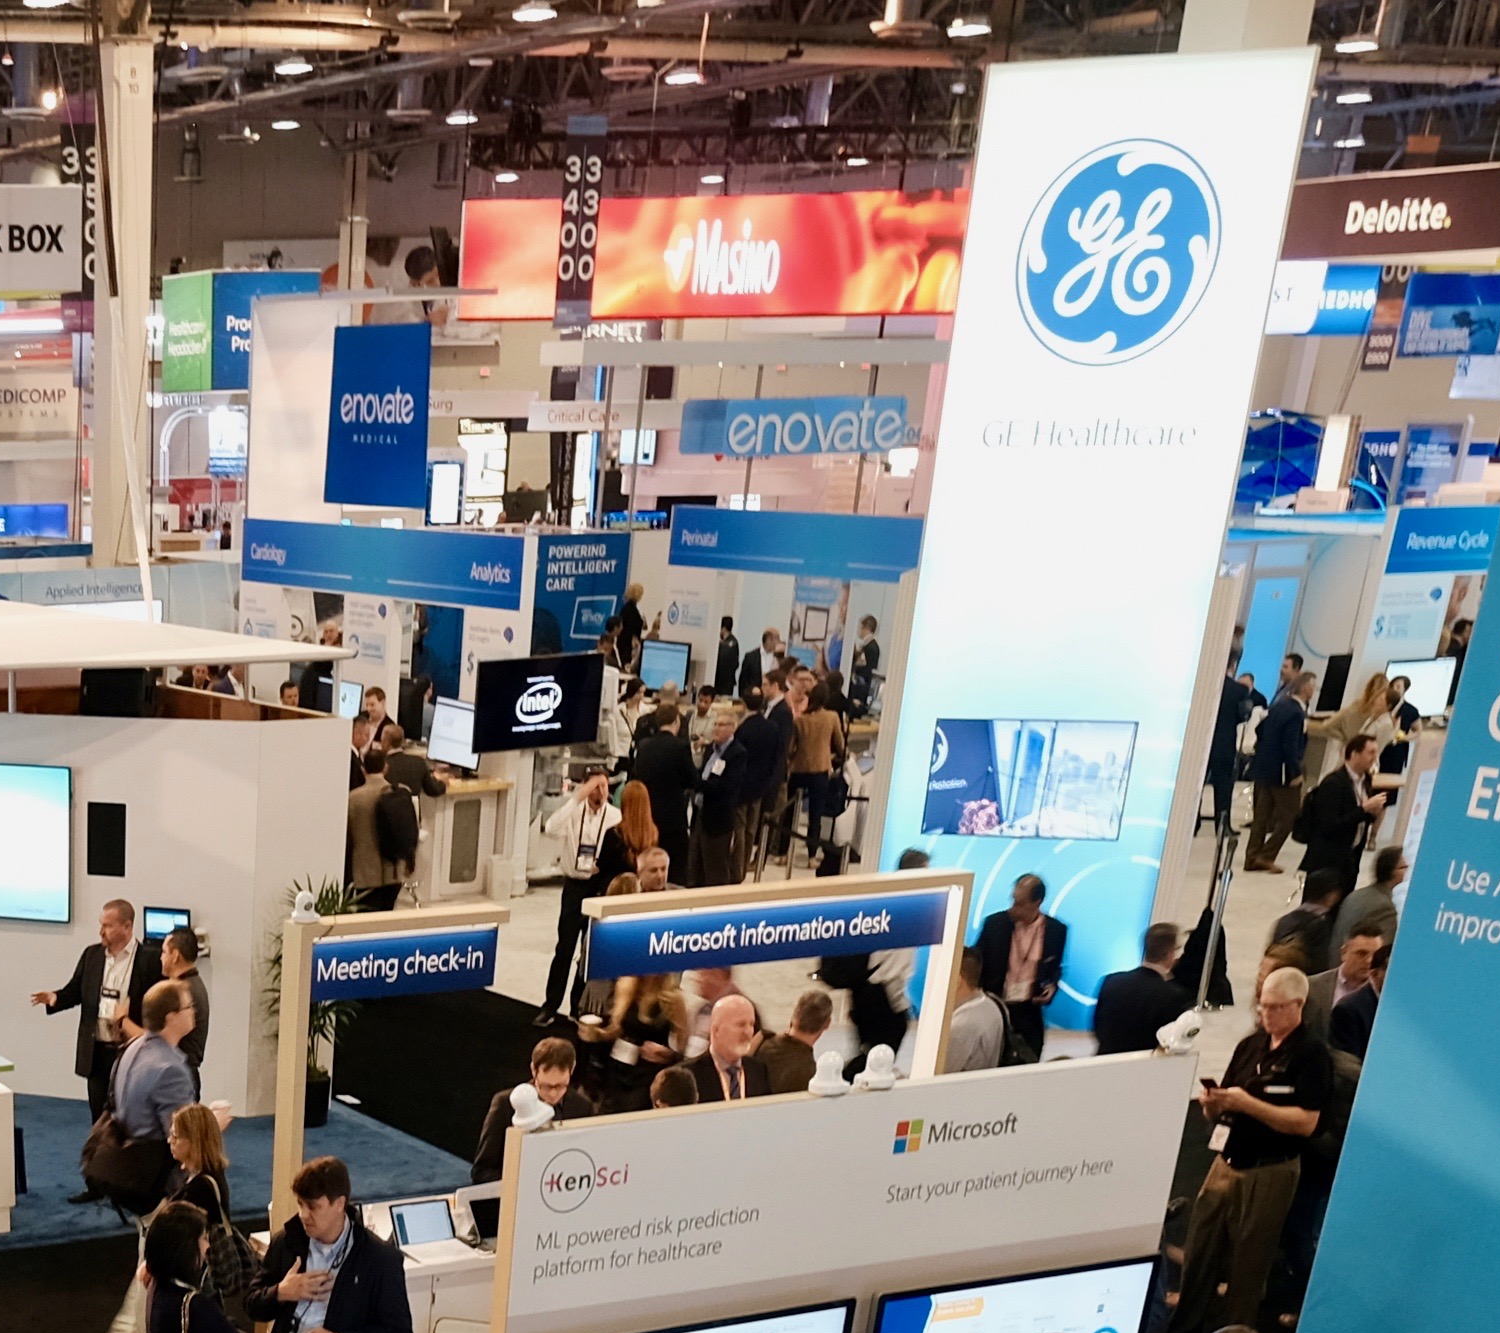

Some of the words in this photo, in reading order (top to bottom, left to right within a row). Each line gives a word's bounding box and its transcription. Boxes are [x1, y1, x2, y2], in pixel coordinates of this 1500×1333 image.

[1345, 197, 1451, 234] Deloitte.
[8, 225, 64, 252] BOX
[341, 385, 414, 425] enovate
[353, 435, 397, 444] MEDICAL
[728, 400, 901, 454] enovate
[982, 420, 1016, 447] GE
[1033, 418, 1196, 447] Healthcare
[549, 544, 606, 559] POWERING
[681, 529, 718, 547] Perinatal
[1407, 532, 1456, 550] Revenue
[1459, 529, 1489, 551] Cycle
[251, 543, 286, 566] Cardiology
[547, 560, 617, 575] INTELLIGENT
[470, 562, 511, 585] Analytics
[546, 577, 575, 591] CARE
[46, 584, 82, 597] Applied
[86, 582, 143, 597] Intelligence
[649, 929, 736, 957] Microsoft
[740, 917, 846, 947] information
[848, 910, 891, 937] desk
[317, 954, 398, 984] Meeting
[403, 947, 484, 977] check-in
[927, 1112, 1018, 1144] Microsoft
[544, 1163, 629, 1194] KenSci
[535, 1231, 563, 1252] ML
[567, 1218, 642, 1250] powered
[645, 1213, 674, 1238] risk
[677, 1205, 760, 1237] prediction
